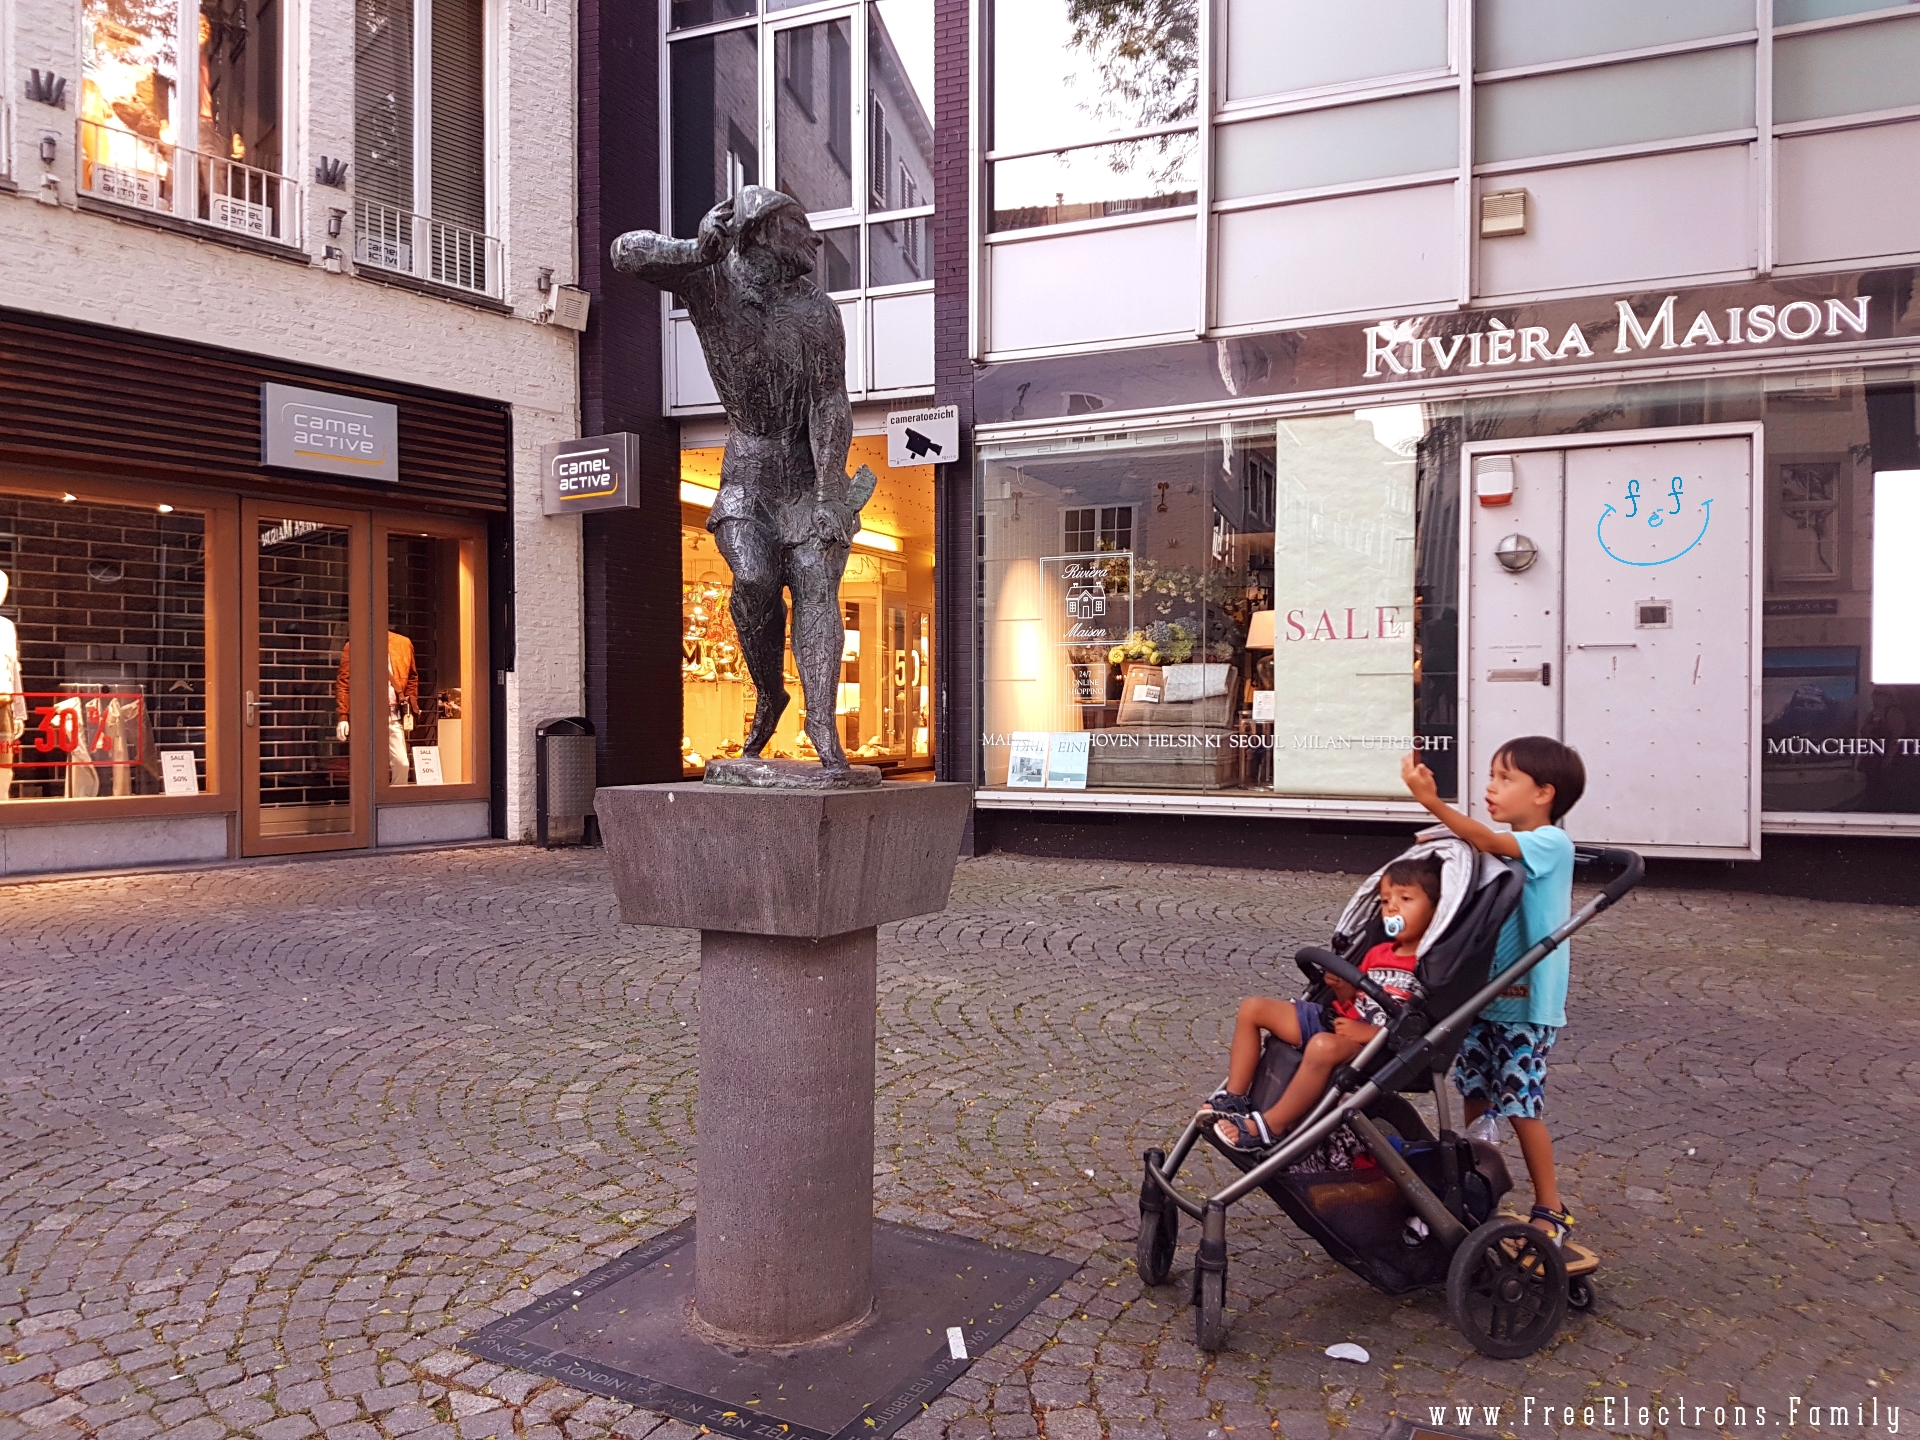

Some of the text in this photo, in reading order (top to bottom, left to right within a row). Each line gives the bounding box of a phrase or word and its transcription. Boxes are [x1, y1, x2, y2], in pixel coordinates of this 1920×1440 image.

[1614, 296, 1872, 353] MAISON
[890, 409, 954, 424] cameratoezicht
[1063, 622, 1107, 638] Maison
[1285, 607, 1400, 642] SALE
[1079, 670, 1092, 678] 24/7
[1068, 687, 1104, 695] SHOPPING
[1148, 733, 1221, 748] HELSINKI
[1229, 734, 1285, 749] SEOUL
[1293, 734, 1353, 749] MILAN
[1362, 735, 1453, 750] UTRECHT
[1767, 736, 1886, 755] MÜNCHEN
